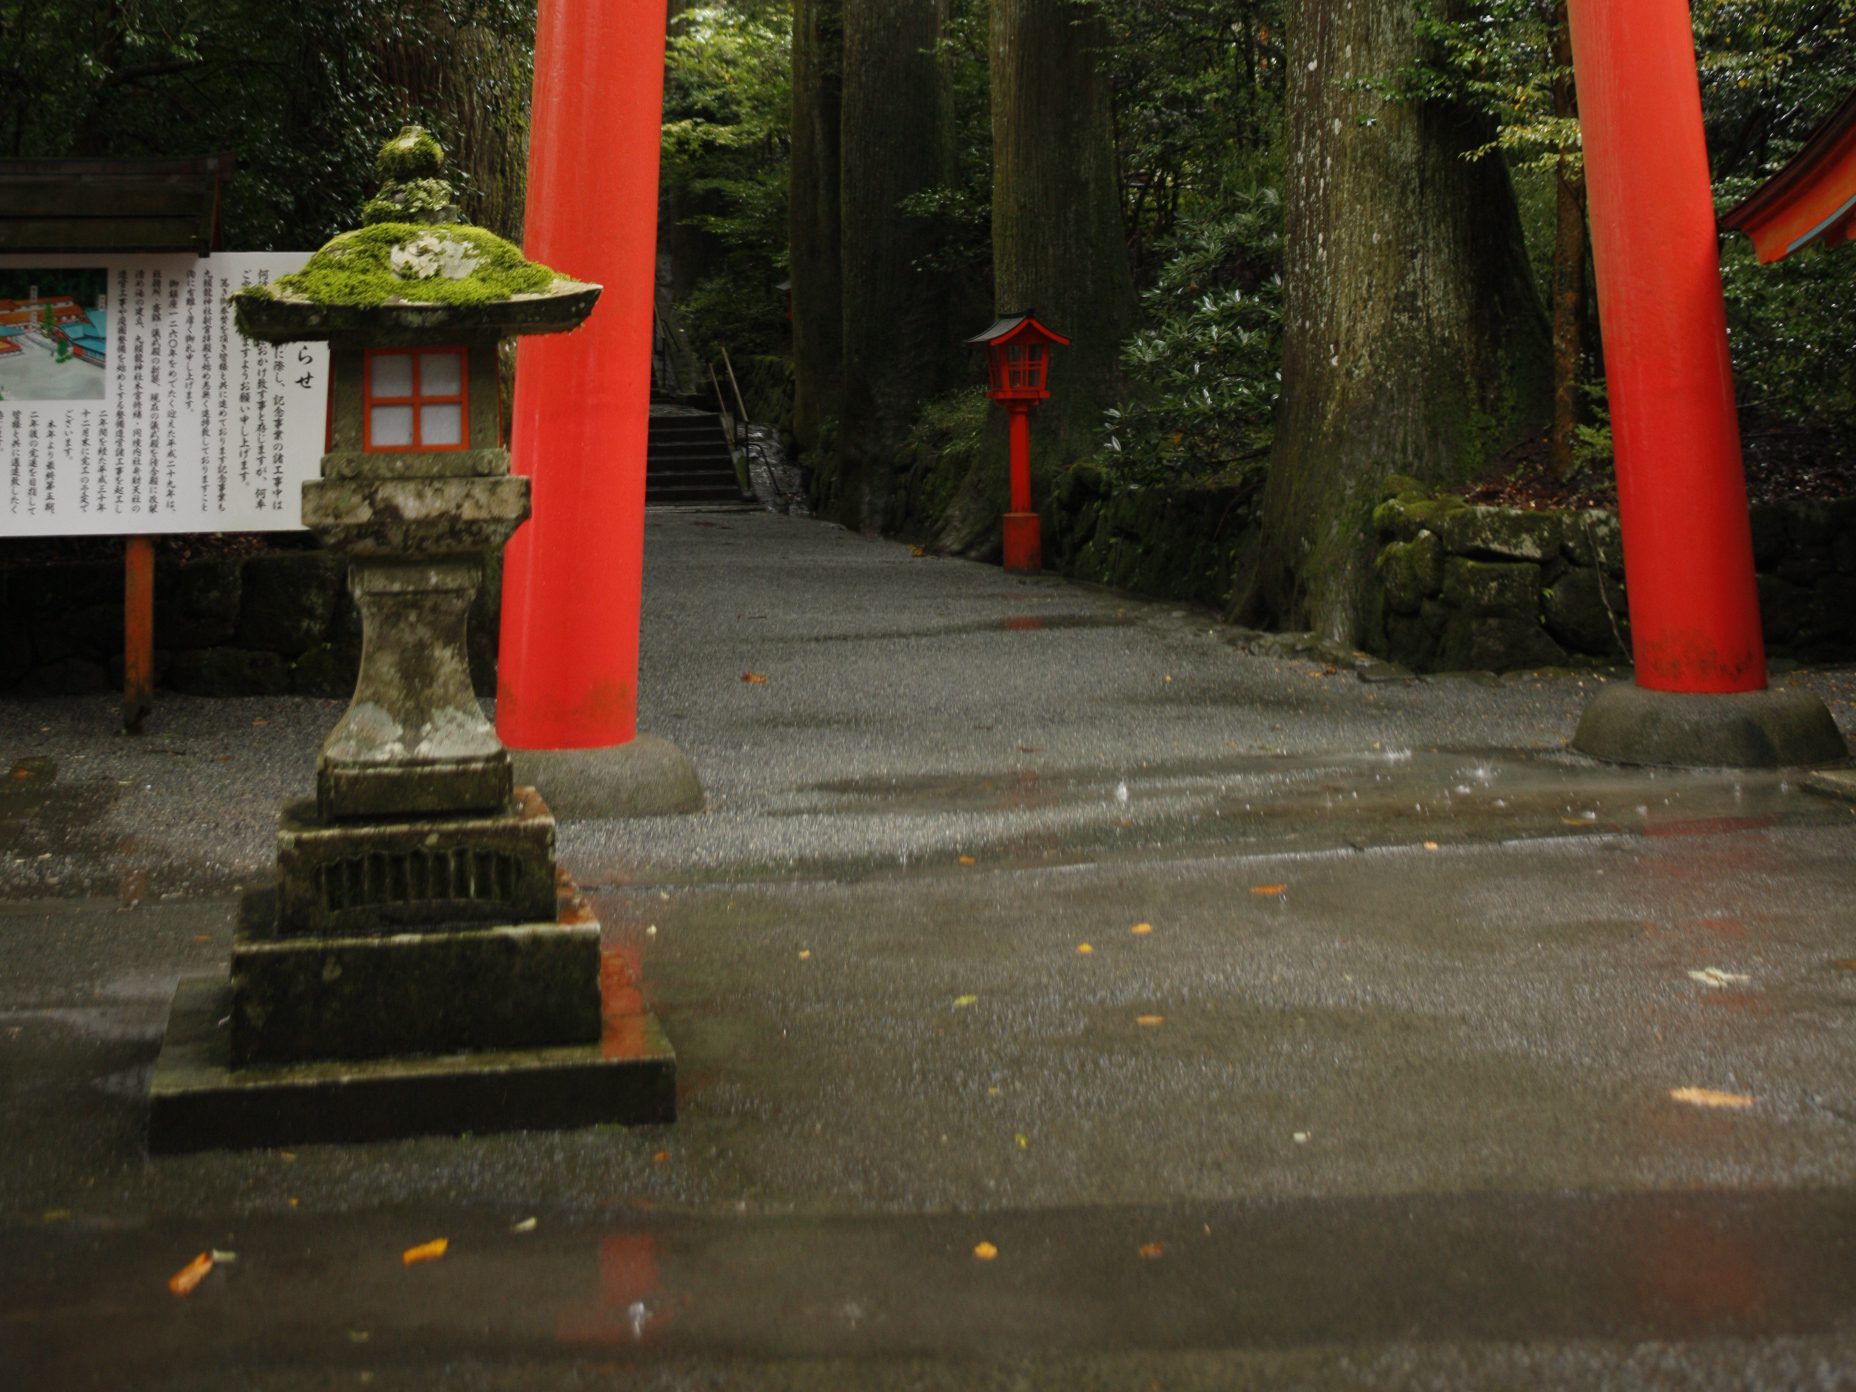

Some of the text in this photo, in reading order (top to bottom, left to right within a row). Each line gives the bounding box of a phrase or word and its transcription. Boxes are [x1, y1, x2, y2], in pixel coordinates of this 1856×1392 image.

[272, 345, 286, 510] に際し、記念事業の諸工事中は
